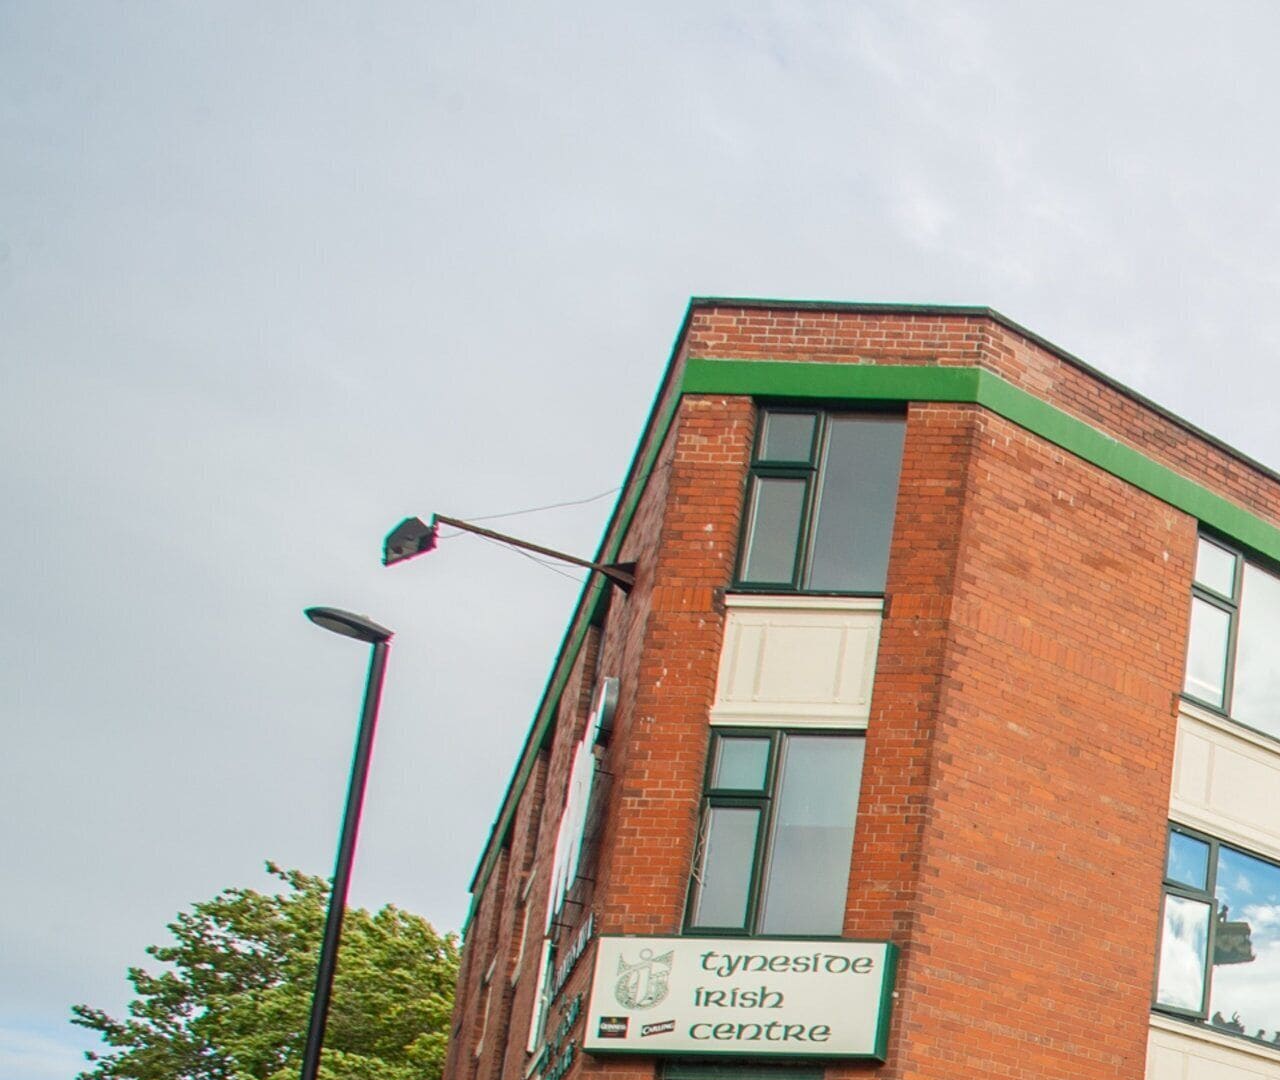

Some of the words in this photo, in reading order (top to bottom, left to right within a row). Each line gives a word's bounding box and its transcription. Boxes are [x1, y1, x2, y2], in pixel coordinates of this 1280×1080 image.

[700, 950, 874, 978] tyneside
[694, 986, 785, 1009] irish
[688, 1020, 832, 1042] centre
